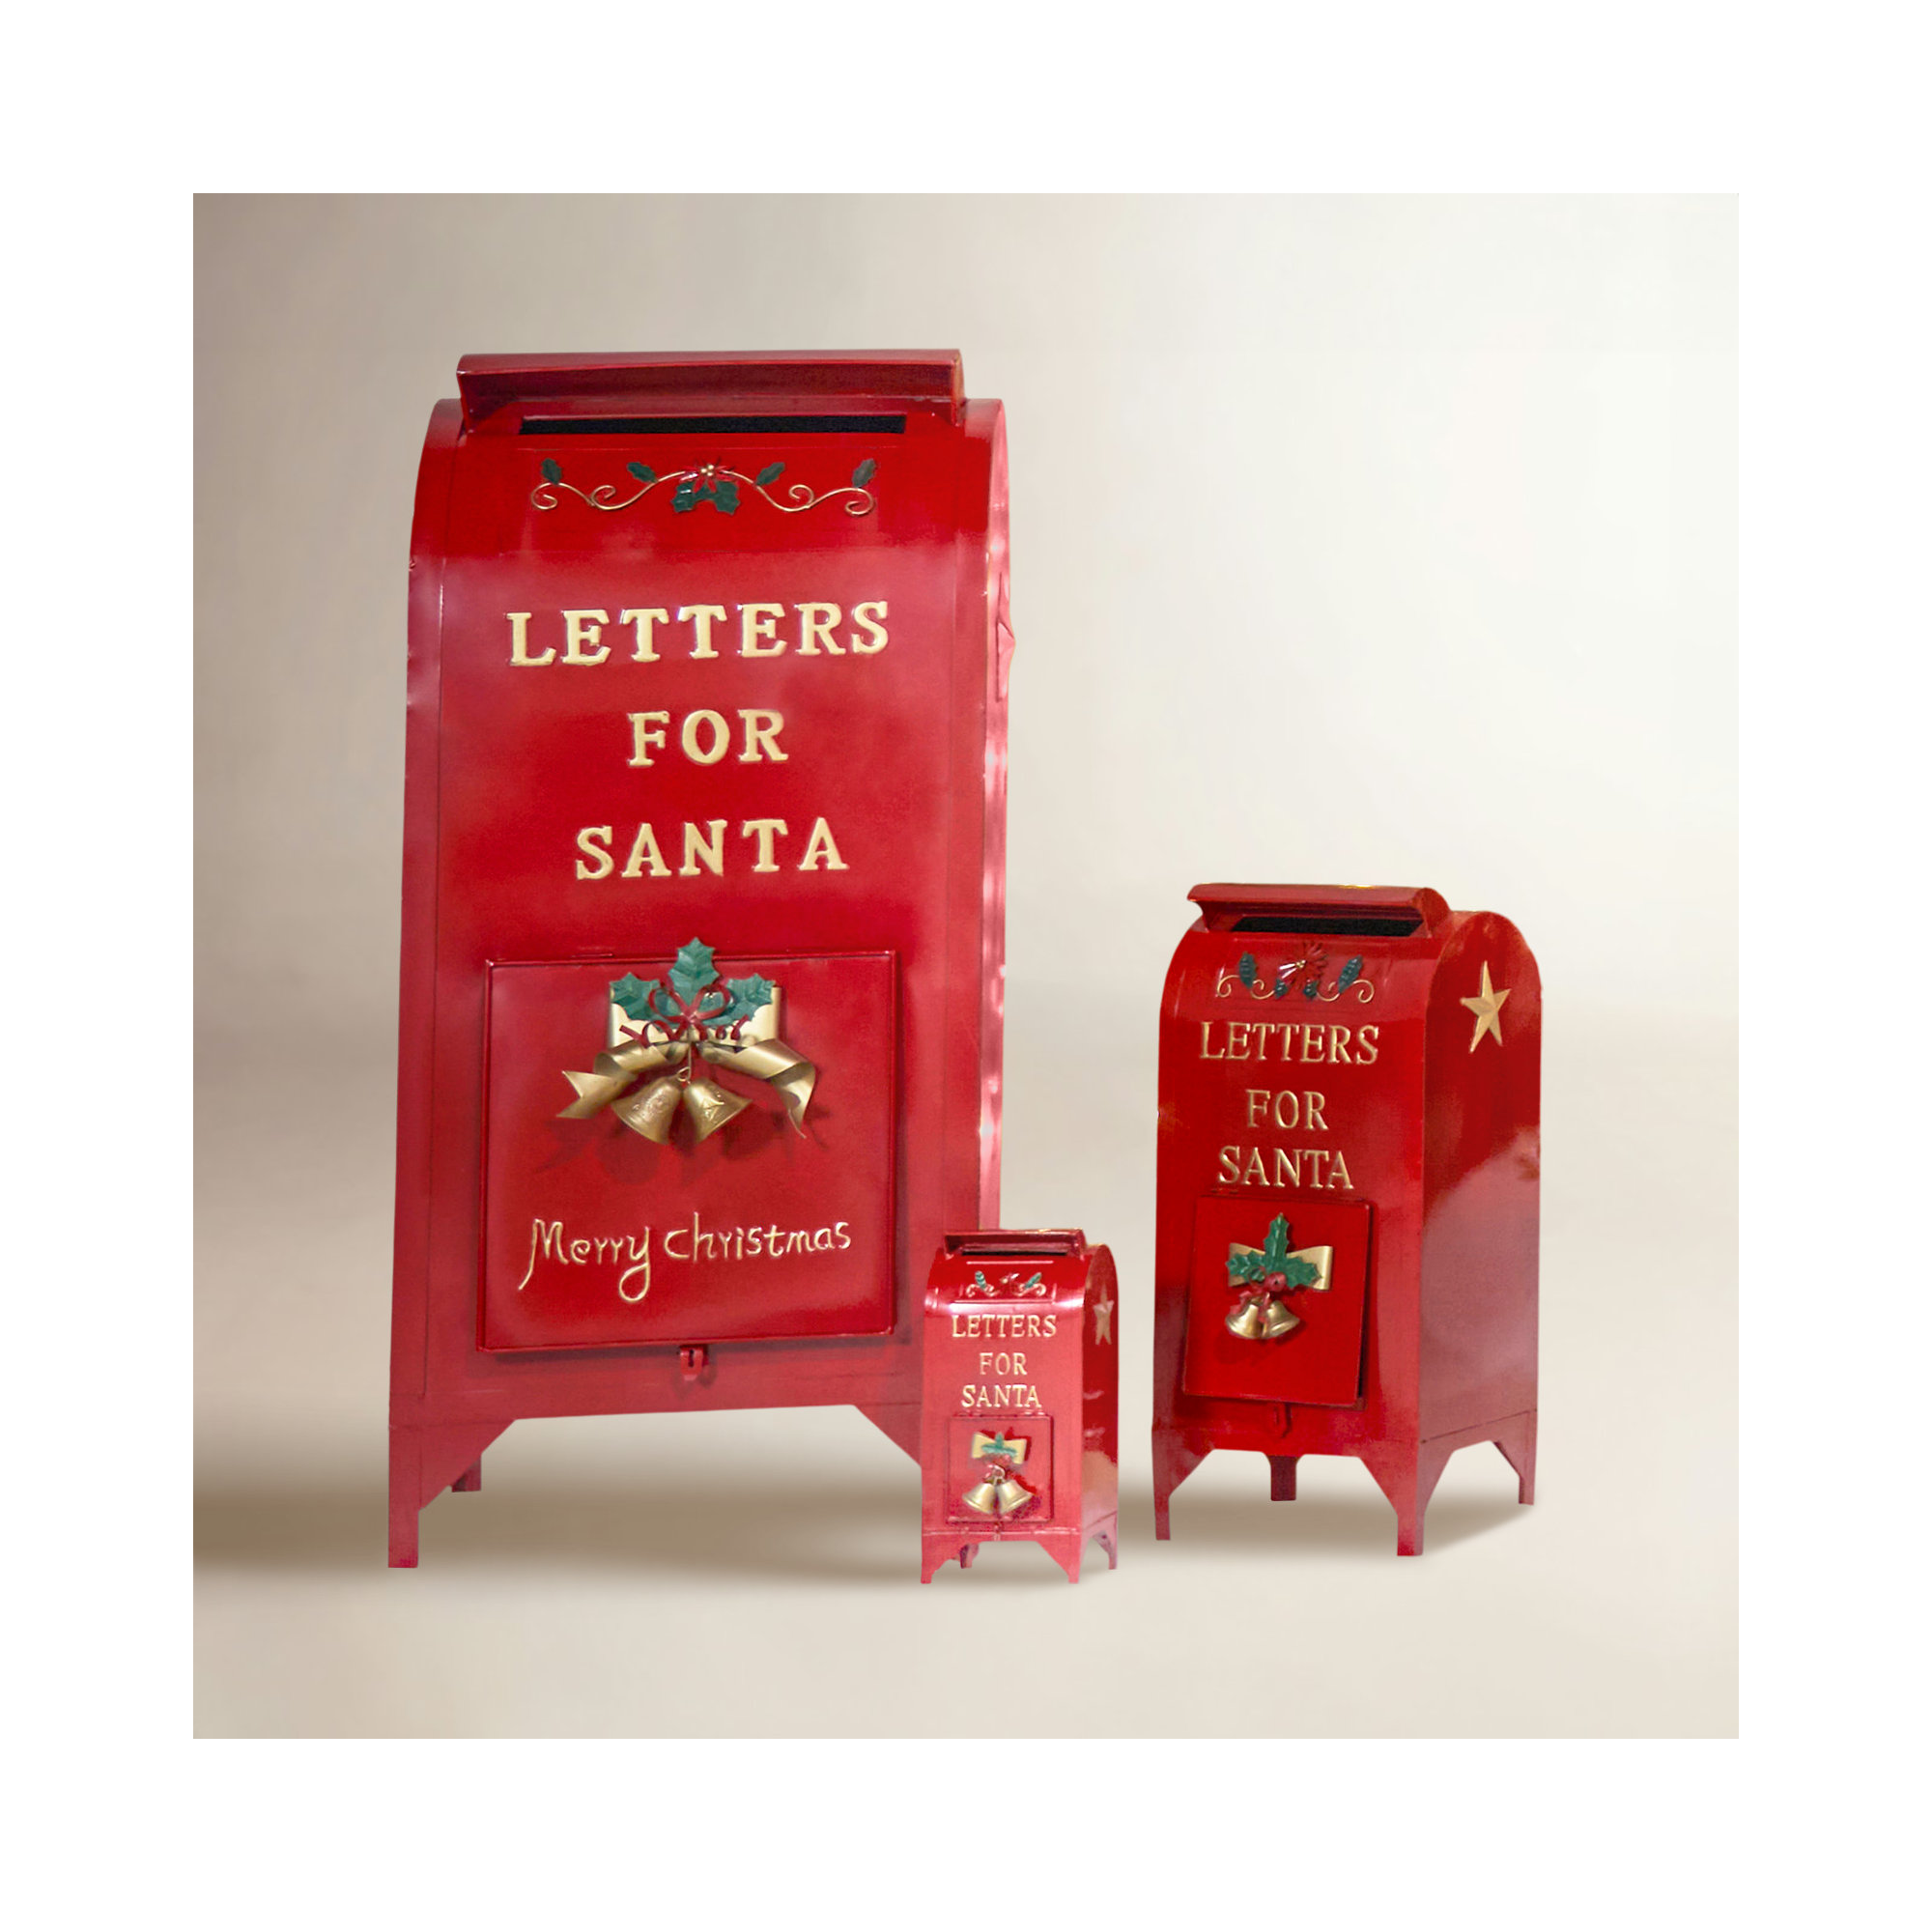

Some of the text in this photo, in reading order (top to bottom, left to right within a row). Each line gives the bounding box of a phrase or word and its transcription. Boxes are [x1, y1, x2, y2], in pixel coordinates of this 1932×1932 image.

[506, 601, 889, 667] LETTERS
[628, 709, 788, 766] FOR
[576, 817, 850, 880] SANTA
[1199, 1021, 1379, 1065] LETTERS
[1245, 1089, 1329, 1130] FOR
[1217, 1145, 1354, 1189] SANTA
[519, 1218, 651, 1302] Merry
[952, 1314, 1057, 1338] LETTERS
[980, 1352, 1027, 1376] FOR
[961, 1384, 1042, 1407] SANTA
